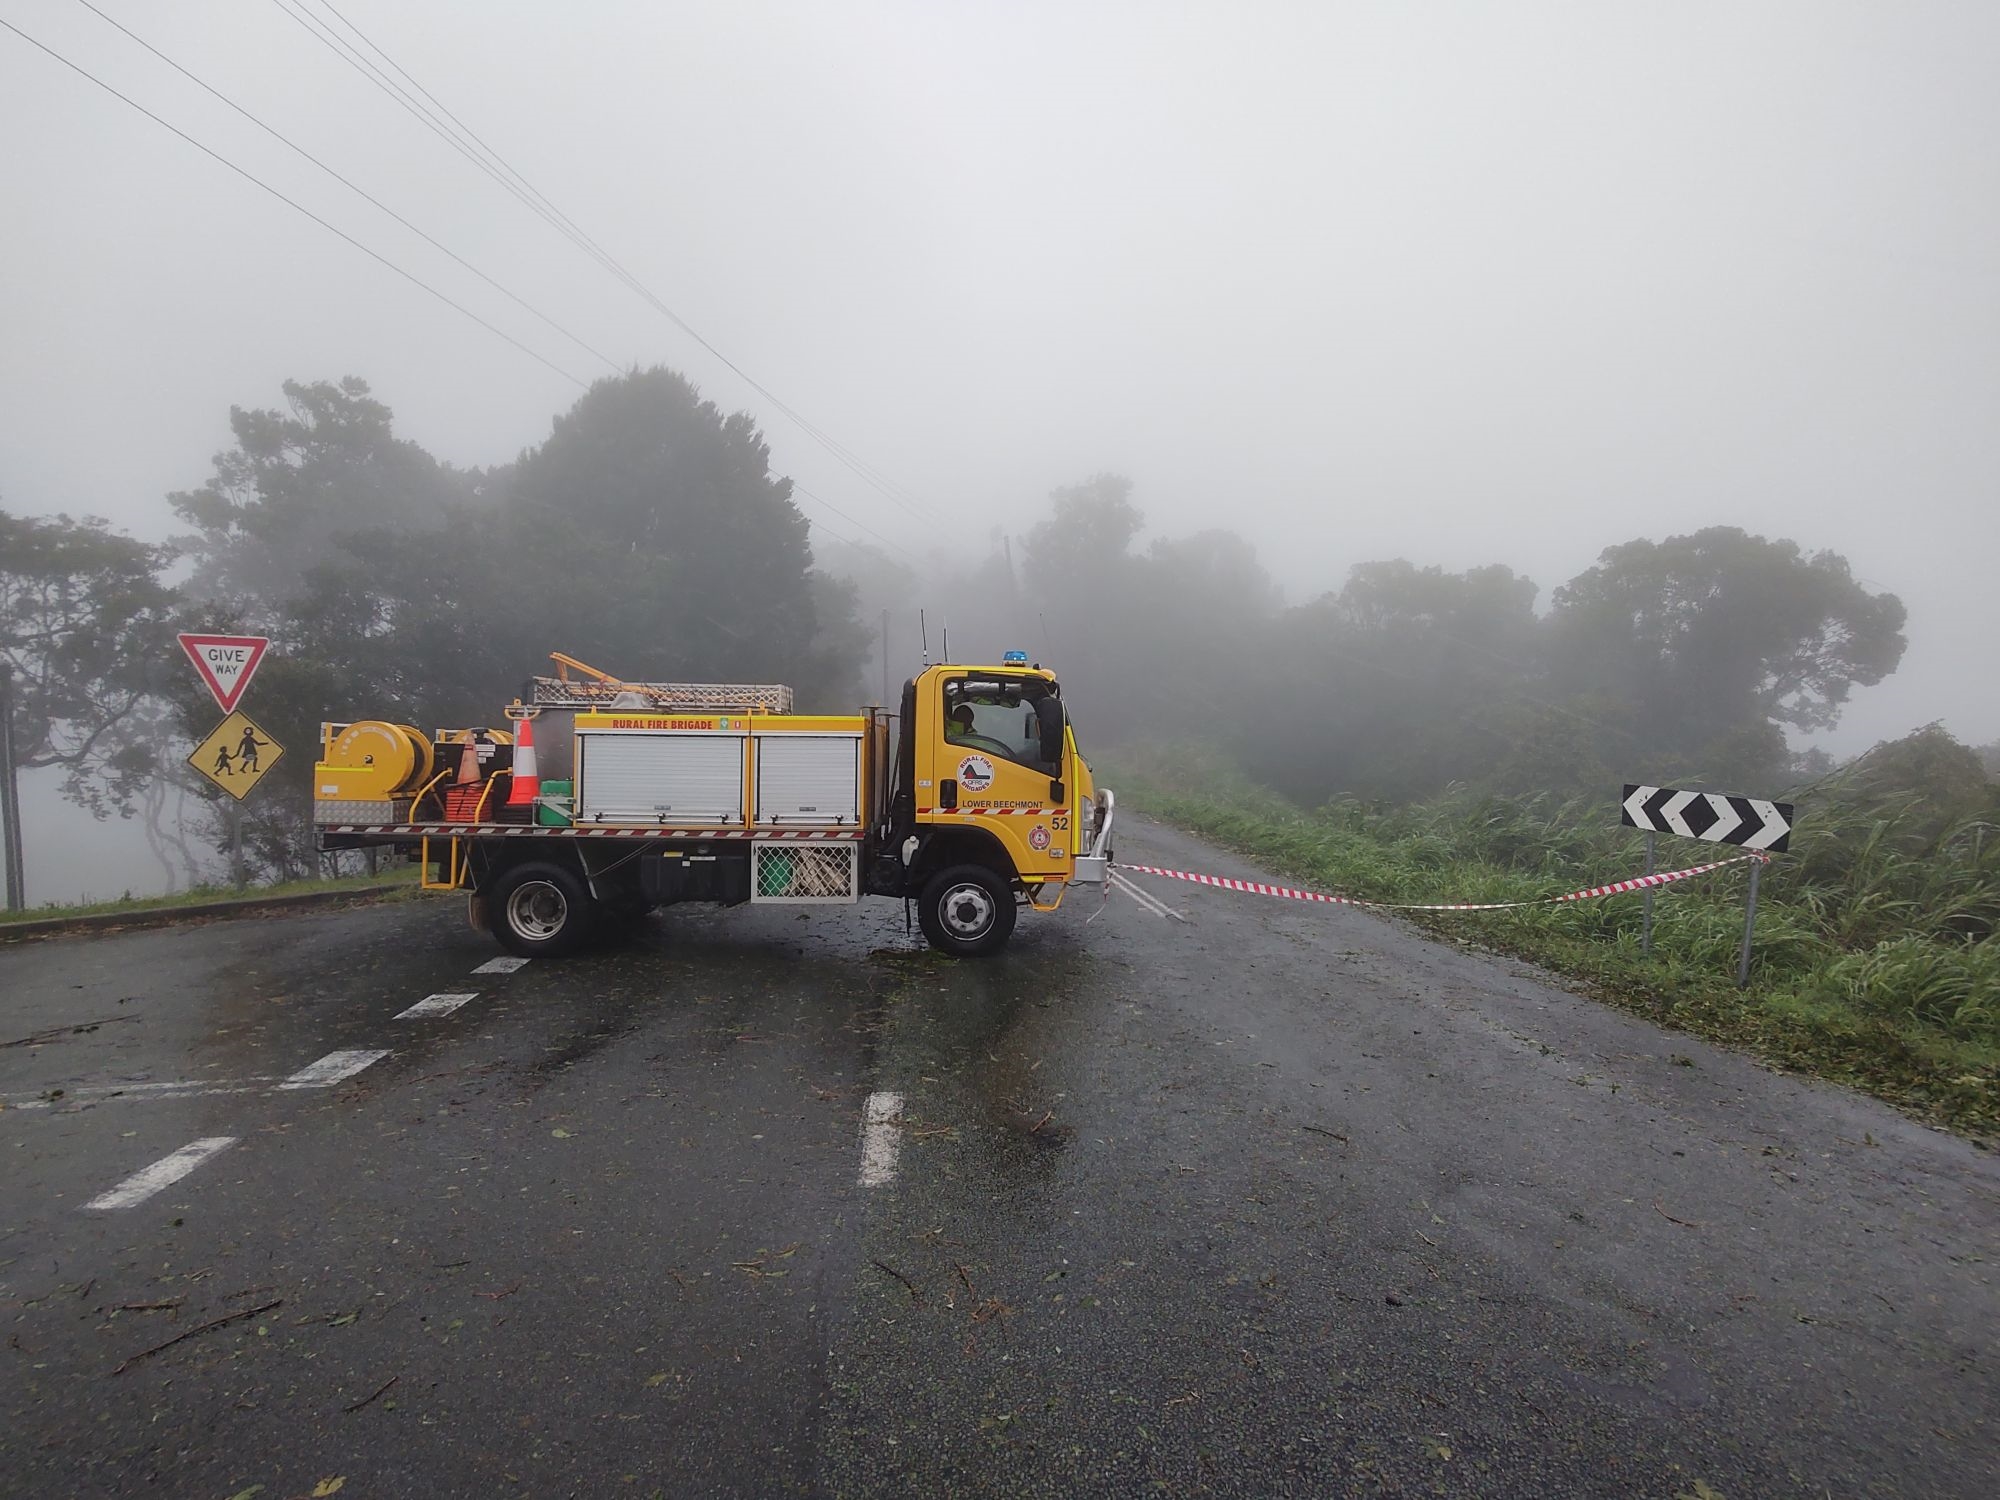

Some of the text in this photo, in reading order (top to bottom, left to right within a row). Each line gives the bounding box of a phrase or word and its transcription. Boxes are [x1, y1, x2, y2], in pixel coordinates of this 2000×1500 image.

[208, 648, 245, 663] GIVE
[215, 664, 238, 675] WAY
[612, 719, 713, 730] RURAL FIRE BRIGADE
[959, 756, 993, 770] RURAL FIRE
[961, 781, 990, 792] BRIGADES
[962, 800, 1044, 809] LOWER BEECHMONT
[1051, 817, 1068, 831] 52
